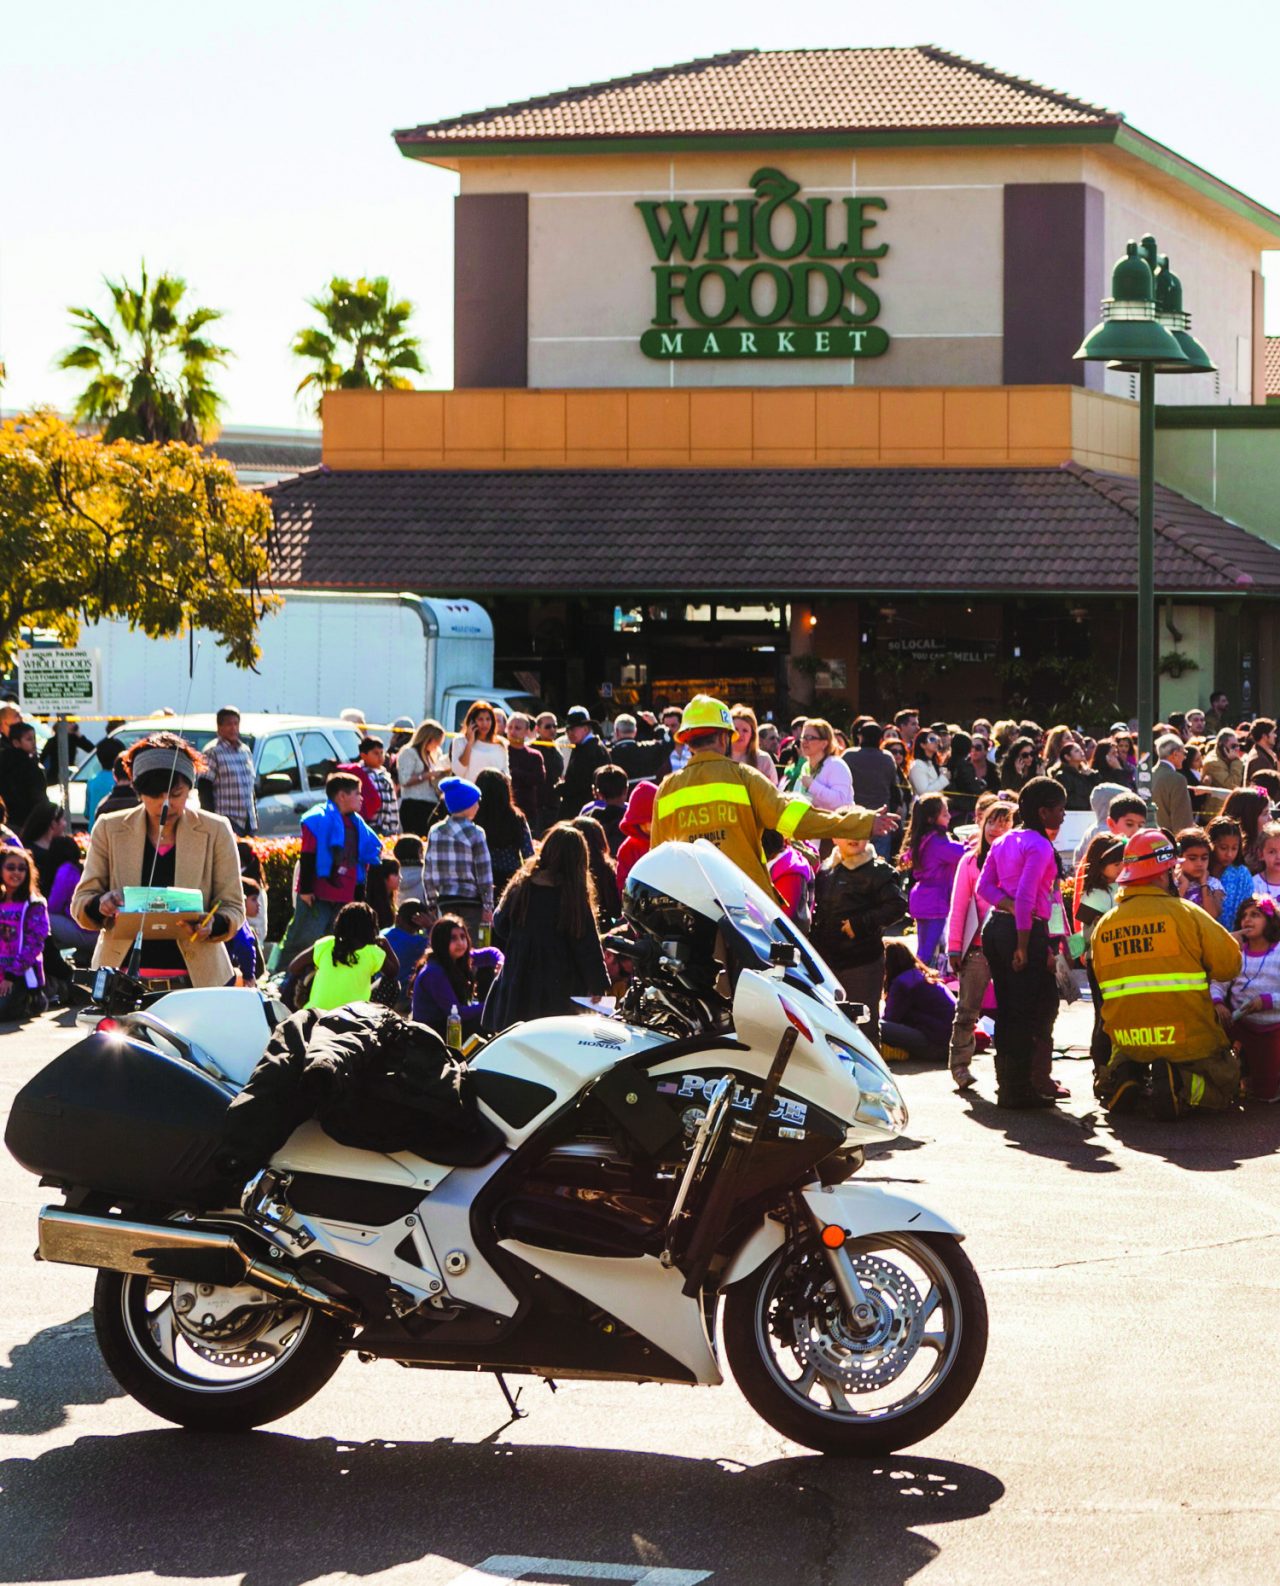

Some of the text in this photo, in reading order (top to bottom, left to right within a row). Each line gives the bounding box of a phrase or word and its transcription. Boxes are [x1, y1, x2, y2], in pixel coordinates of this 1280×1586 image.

[634, 197, 890, 262] WHOLE
[651, 261, 881, 326] FOODS
[661, 331, 867, 354] MARKET
[23, 660, 92, 668] WHOLE FOODS
[1101, 921, 1166, 944] GLENDALE
[1113, 937, 1154, 958] FIRE
[577, 1039, 621, 1051] HONDA
[1114, 1026, 1176, 1046] MARQUEZ
